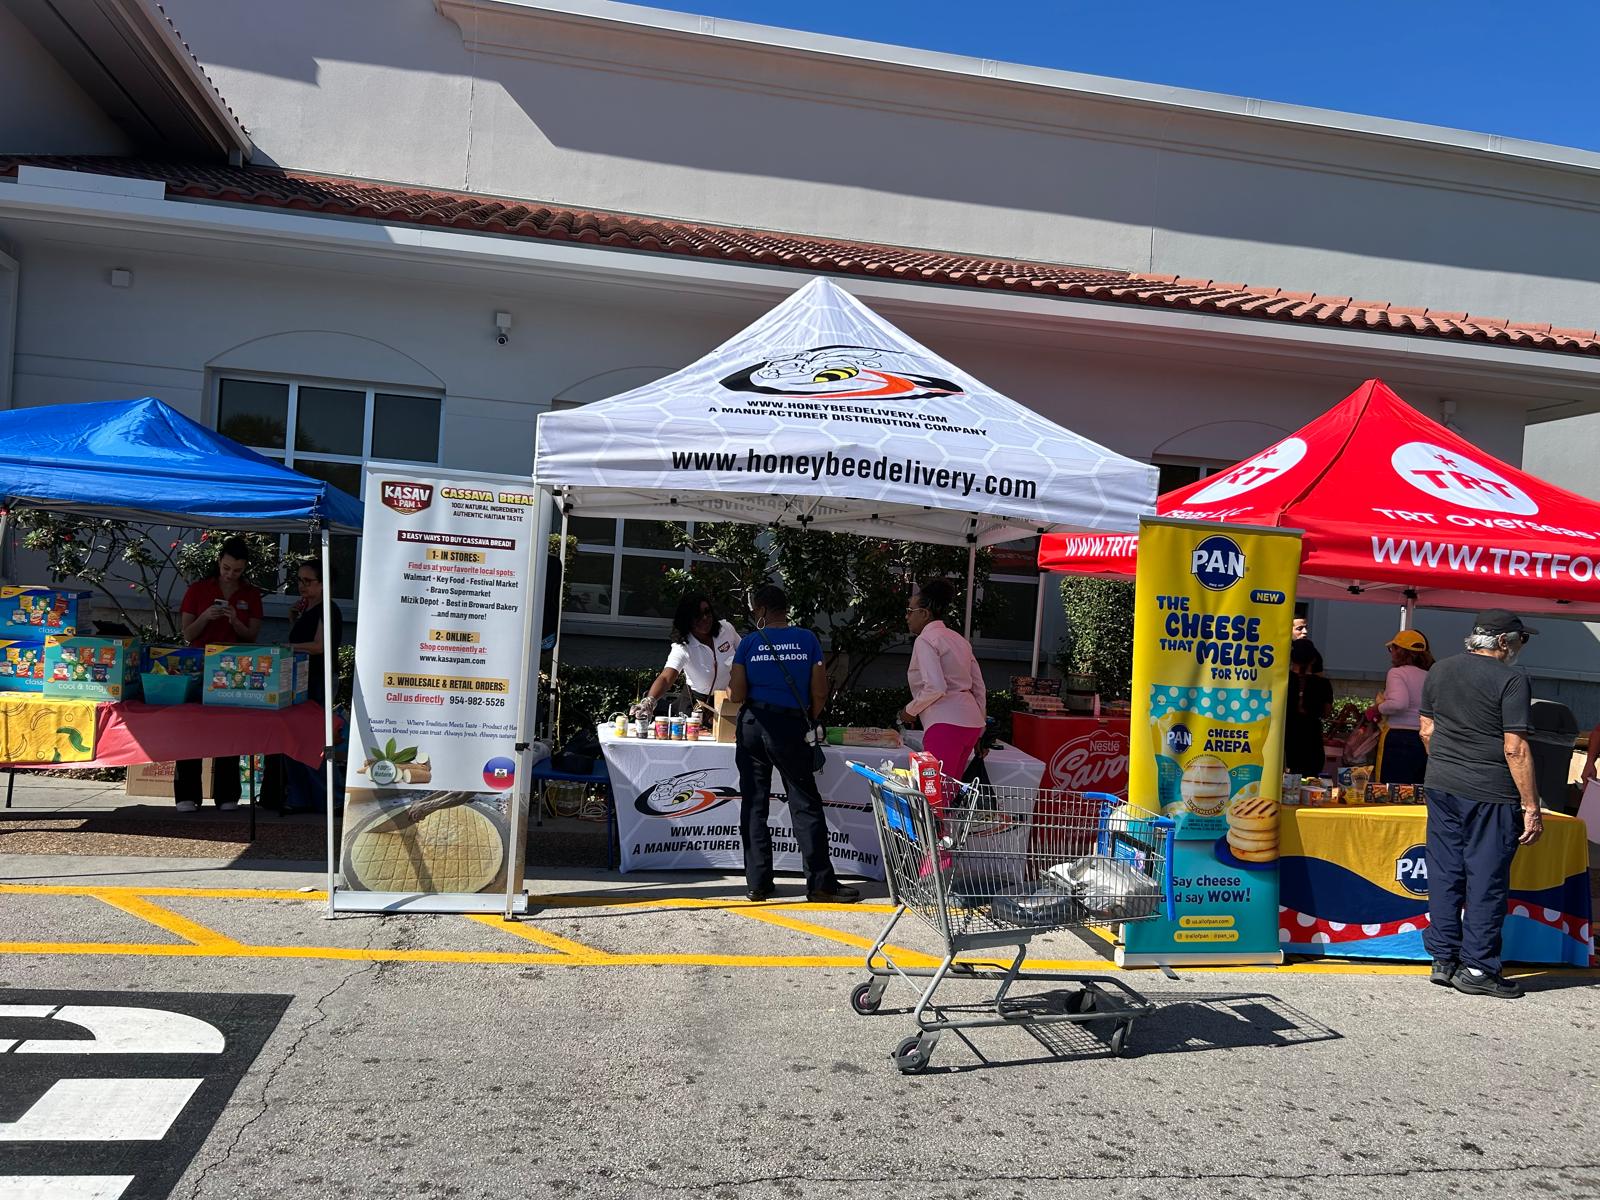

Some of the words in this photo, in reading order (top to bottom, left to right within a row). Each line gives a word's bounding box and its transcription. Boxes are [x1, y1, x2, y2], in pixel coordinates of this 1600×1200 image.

[747, 400, 947, 423] WWW.HONEYBEEDELIVERY.COM
[721, 407, 829, 420] MANUFACTURER
[832, 414, 920, 428] DISTRIBUTION
[924, 423, 987, 436] COMPANY
[672, 448, 1037, 499] www.honeybeedelivery.com
[1222, 466, 1281, 485] RT
[1410, 469, 1516, 500] TRT
[384, 485, 430, 501] KASAV
[441, 488, 494, 502] CASSAVA
[398, 500, 416, 508] PAM
[464, 503, 489, 511] NATURAL
[490, 505, 525, 514] INGREDIENTS
[453, 510, 483, 519] AUTHENTIC
[1371, 507, 1439, 524] TRT
[1446, 514, 1597, 540] Overseas
[407, 532, 422, 540] EASY
[423, 534, 441, 542] WAYS
[462, 537, 490, 545] CASSAVA
[490, 539, 512, 548] BREAD!
[440, 551, 448, 560] IN
[450, 551, 480, 562] STORES:
[408, 562, 423, 570] Find
[439, 565, 453, 573] your
[453, 565, 479, 574] favorite
[479, 566, 495, 575] local
[495, 569, 516, 577] spots:
[403, 572, 431, 582] Walmart
[436, 575, 448, 585] Key
[449, 576, 465, 584] Food
[469, 577, 495, 587] Festival
[495, 580, 519, 588] Market
[430, 586, 449, 594] Bravo
[450, 587, 491, 598] Supermarket
[1256, 592, 1280, 602] NEW
[400, 595, 419, 605] Mizik
[420, 597, 439, 607] Depot
[446, 599, 461, 607] Best
[468, 600, 495, 610] Broward
[496, 602, 519, 612] Bakery
[1156, 595, 1190, 612] THE
[450, 612, 468, 621] many
[468, 612, 487, 621] more!
[1165, 612, 1261, 643] CHEESE
[445, 632, 474, 642] ONLINE:
[419, 642, 436, 651] Shop
[437, 645, 478, 654] conveniently
[1160, 638, 1194, 653] THAT
[1196, 640, 1275, 668] MELTS
[419, 655, 486, 665] www.kasavpam.com
[1211, 668, 1232, 680] FOR
[1234, 668, 1258, 681] YOU
[397, 677, 440, 688] WHOLESALE
[441, 679, 447, 688] &
[449, 680, 473, 690] RETAIL
[475, 681, 506, 691] ORDERS:
[386, 692, 402, 702] Call
[414, 694, 445, 706] directly
[449, 696, 505, 707] 954-982-5526
[1207, 728, 1249, 740] CHEESE
[1203, 739, 1252, 754] AREPA
[1053, 748, 1129, 799] Savo
[632, 843, 641, 856] A
[643, 840, 740, 854] MANUFACTURER
[1196, 875, 1241, 887] cheese
[1160, 892, 1182, 903] ad
[1185, 893, 1204, 905] say
[1207, 887, 1251, 903] WOW!
